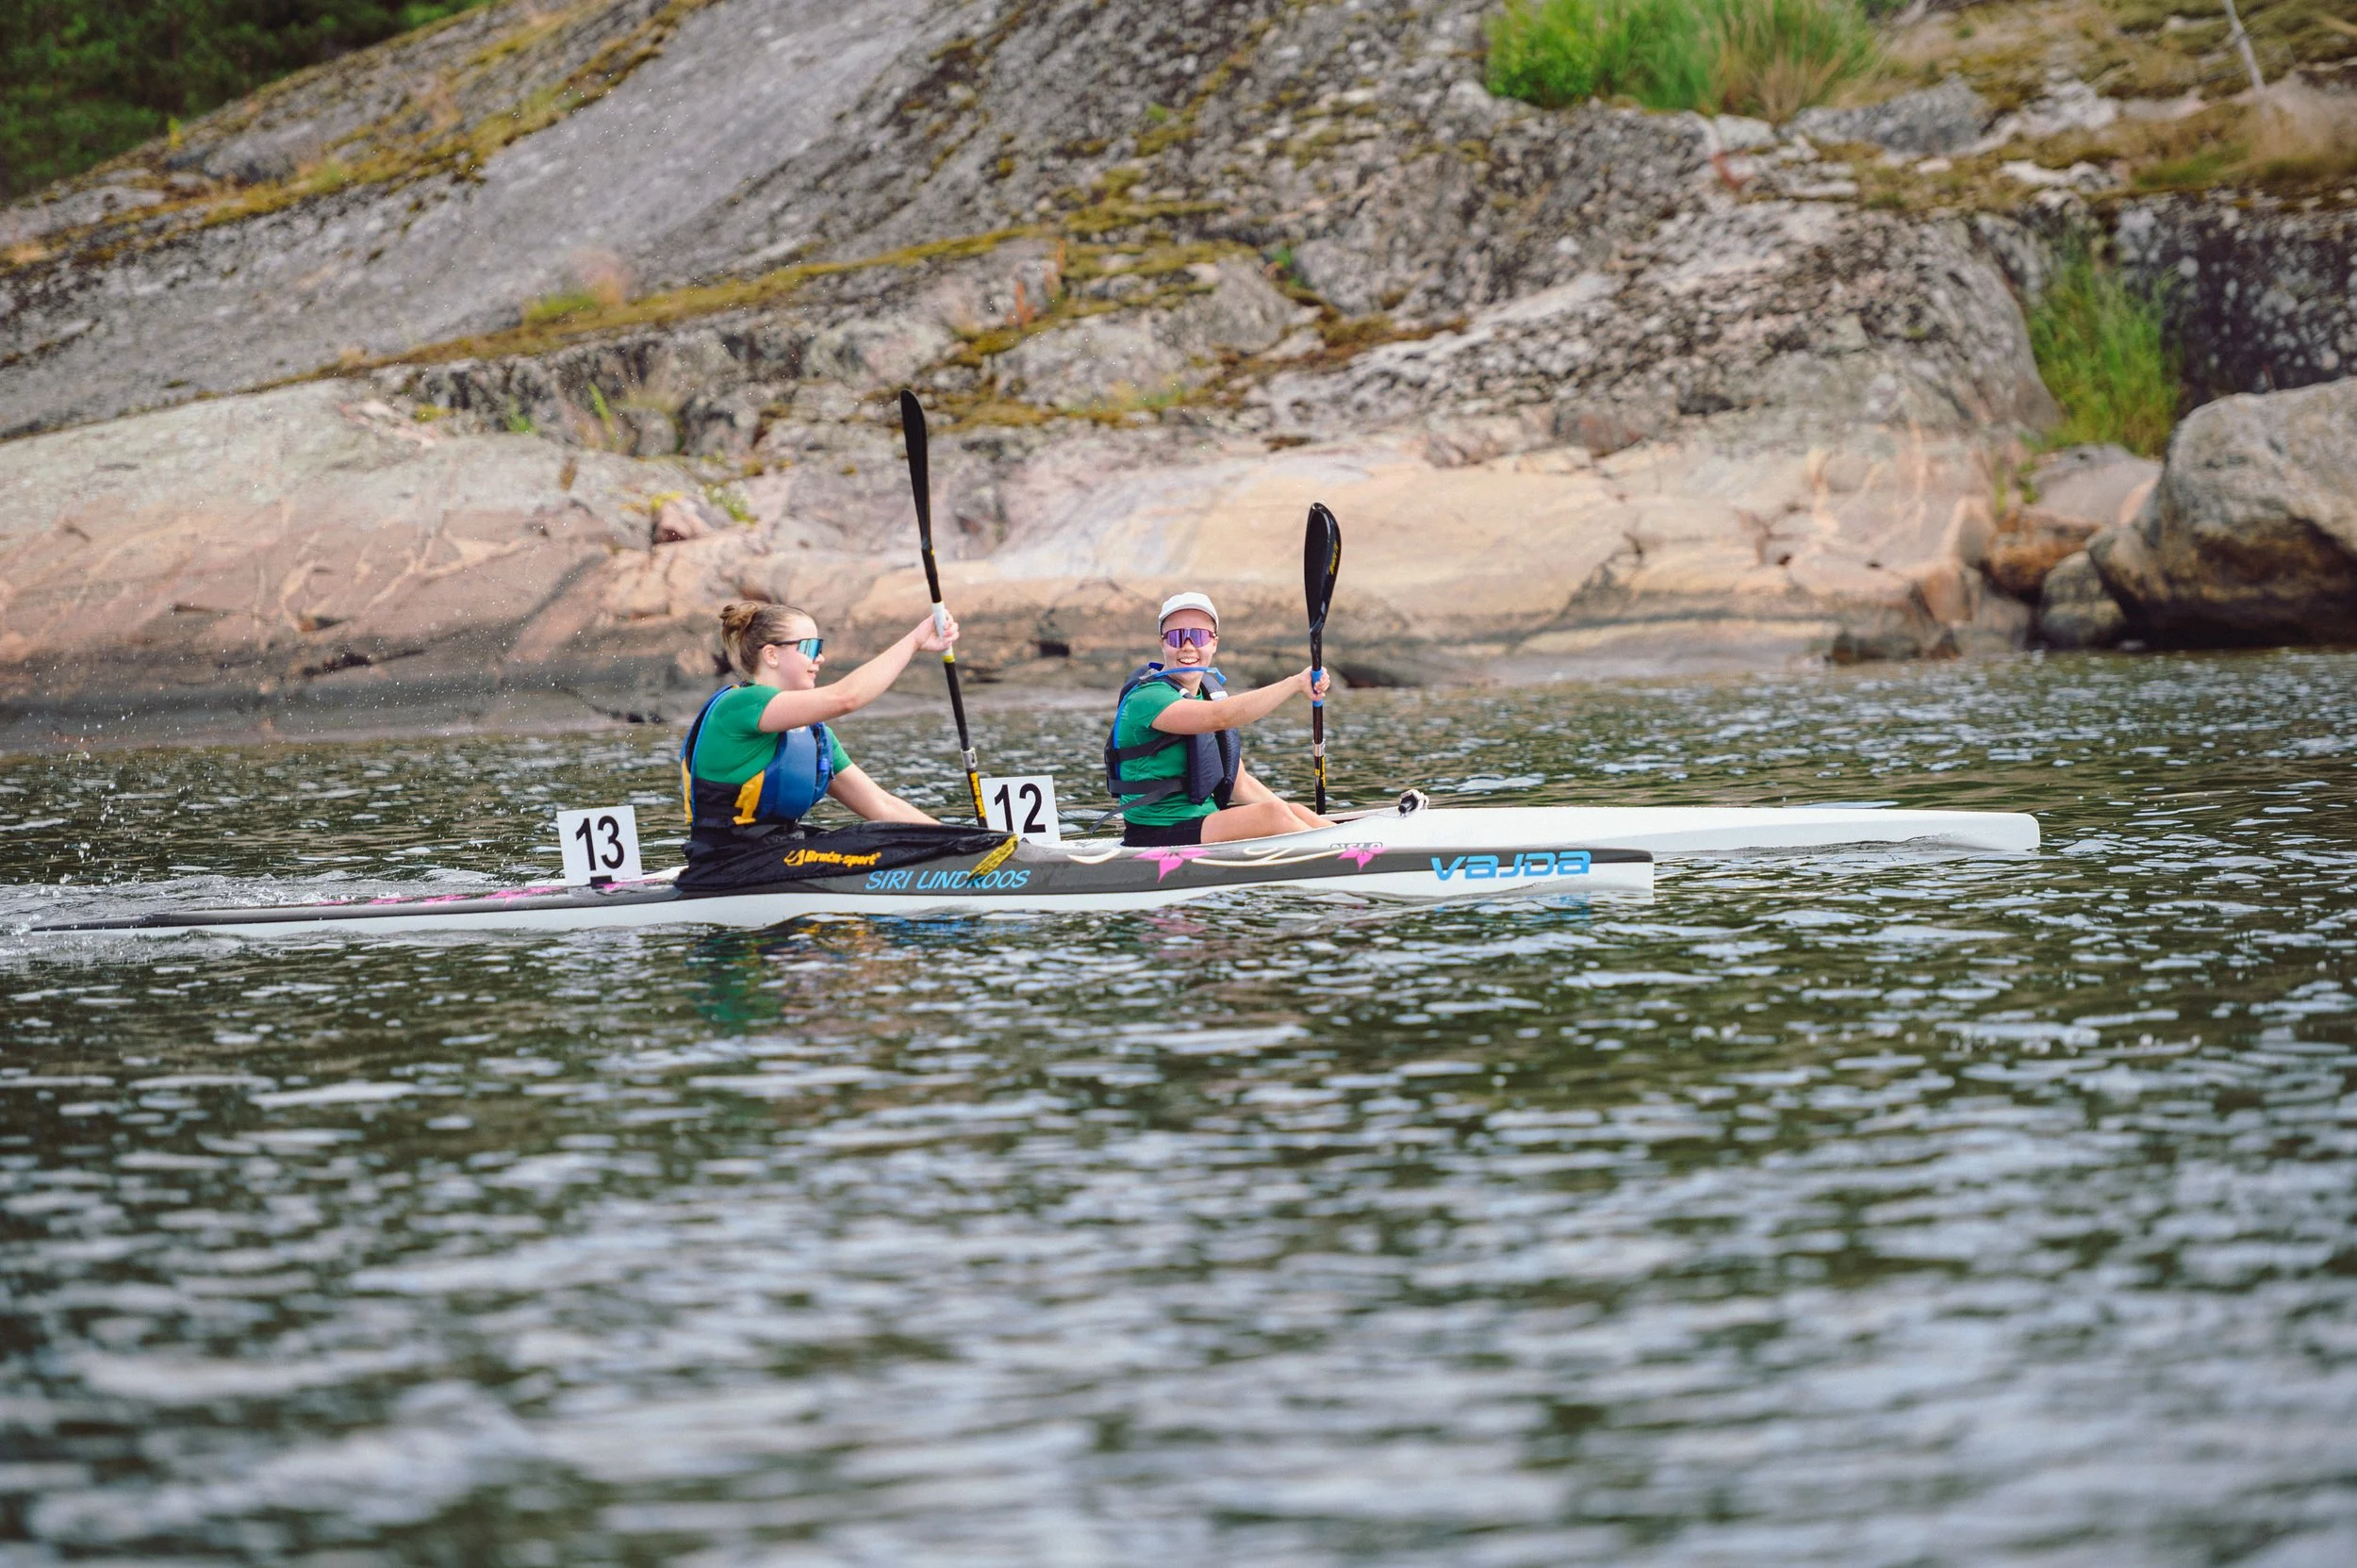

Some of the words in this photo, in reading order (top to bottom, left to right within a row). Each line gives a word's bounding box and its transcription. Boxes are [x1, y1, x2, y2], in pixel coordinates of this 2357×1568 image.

[994, 783, 1047, 834] 12
[575, 815, 625, 871] 13
[865, 869, 915, 890] SIRI
